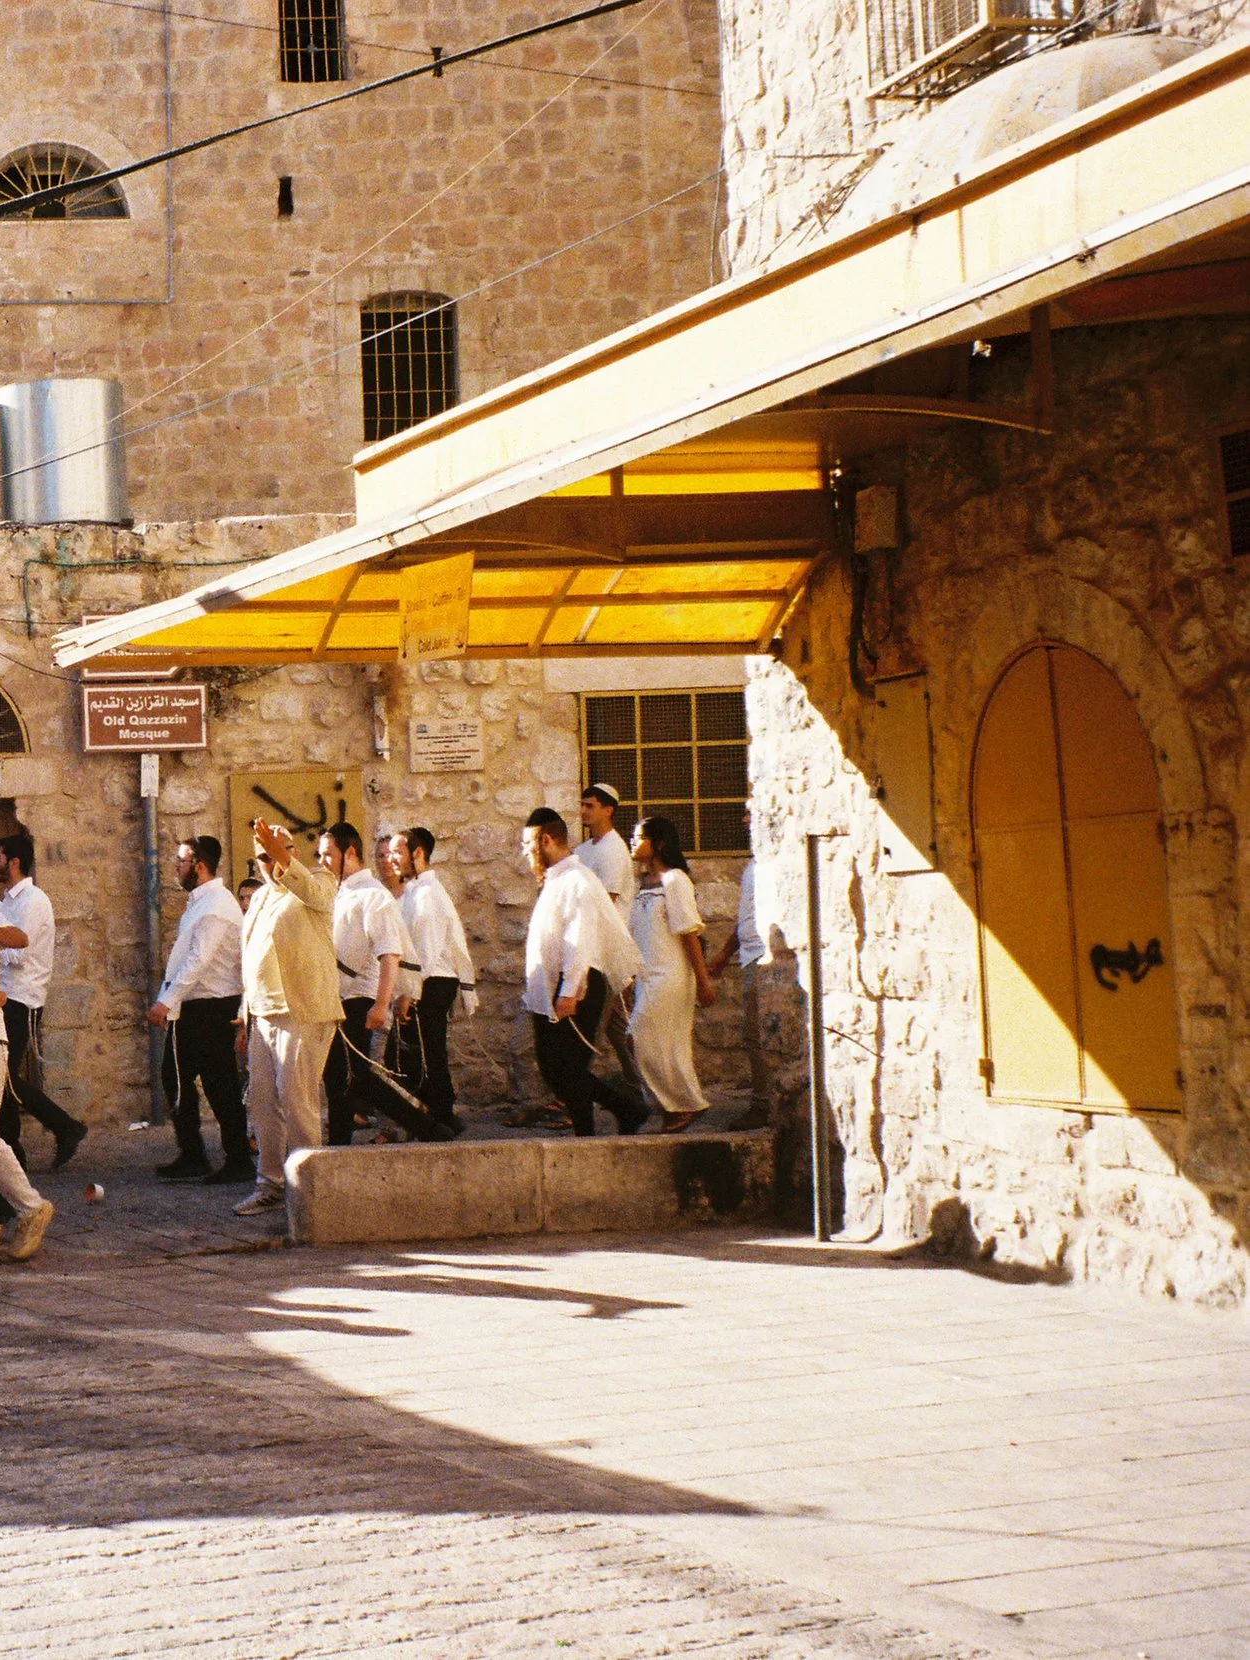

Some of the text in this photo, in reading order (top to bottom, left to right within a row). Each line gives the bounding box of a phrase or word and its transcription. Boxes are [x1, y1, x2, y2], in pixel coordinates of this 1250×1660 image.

[90, 695, 199, 713] مسجد القزازين القديم
[103, 714, 188, 727] Old Qazzazin
[118, 729, 171, 741] Mosque
